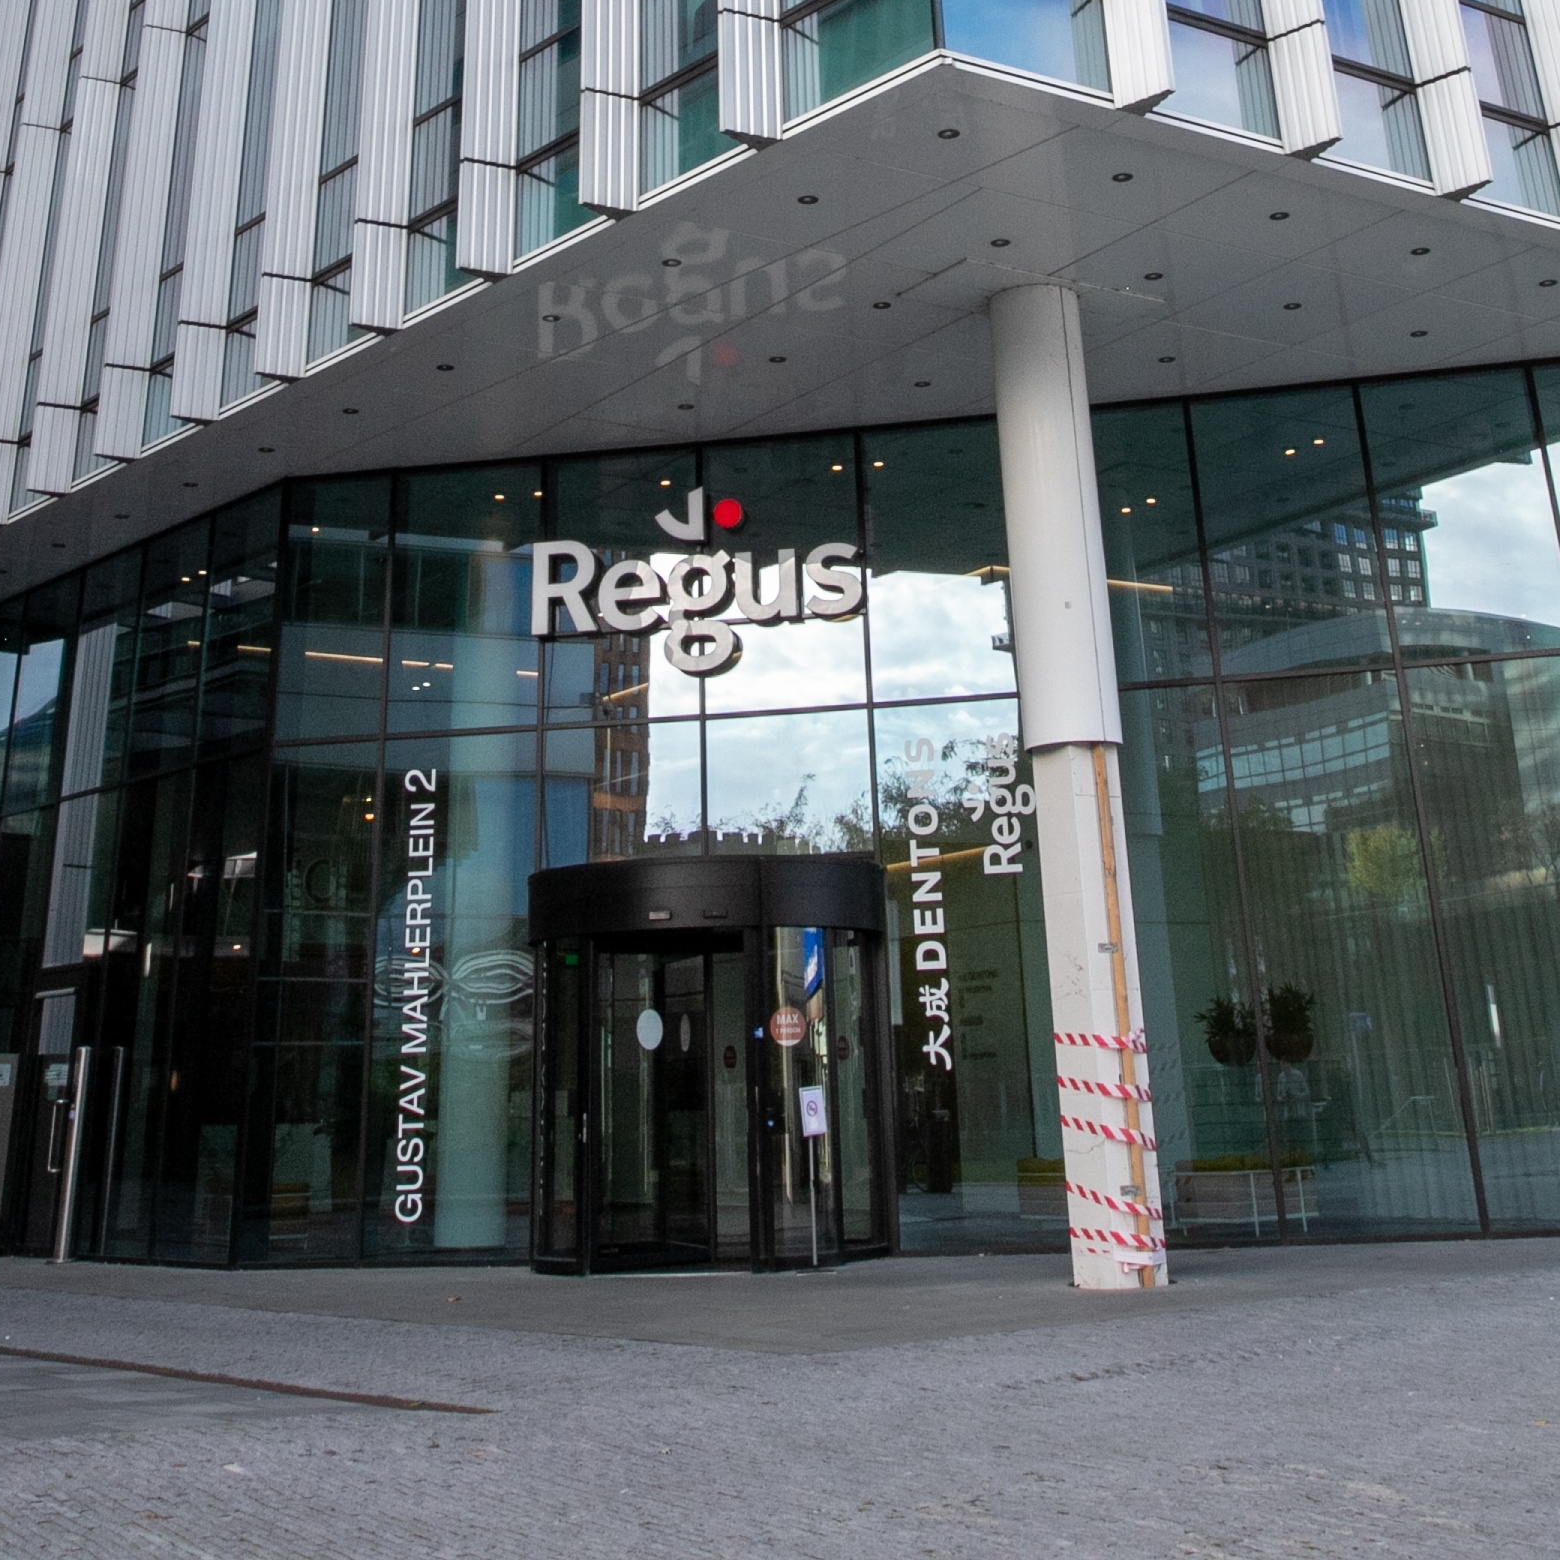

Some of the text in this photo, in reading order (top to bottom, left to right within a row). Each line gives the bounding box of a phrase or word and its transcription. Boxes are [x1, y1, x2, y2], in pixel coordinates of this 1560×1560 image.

[531, 539, 864, 674] Regus
[982, 732, 1036, 875] Regus
[904, 738, 952, 1071] 大成 DENTONS
[395, 767, 437, 1223] GUSTAV MAHLERPLEIN 2
[776, 1013, 799, 1025] MAX
